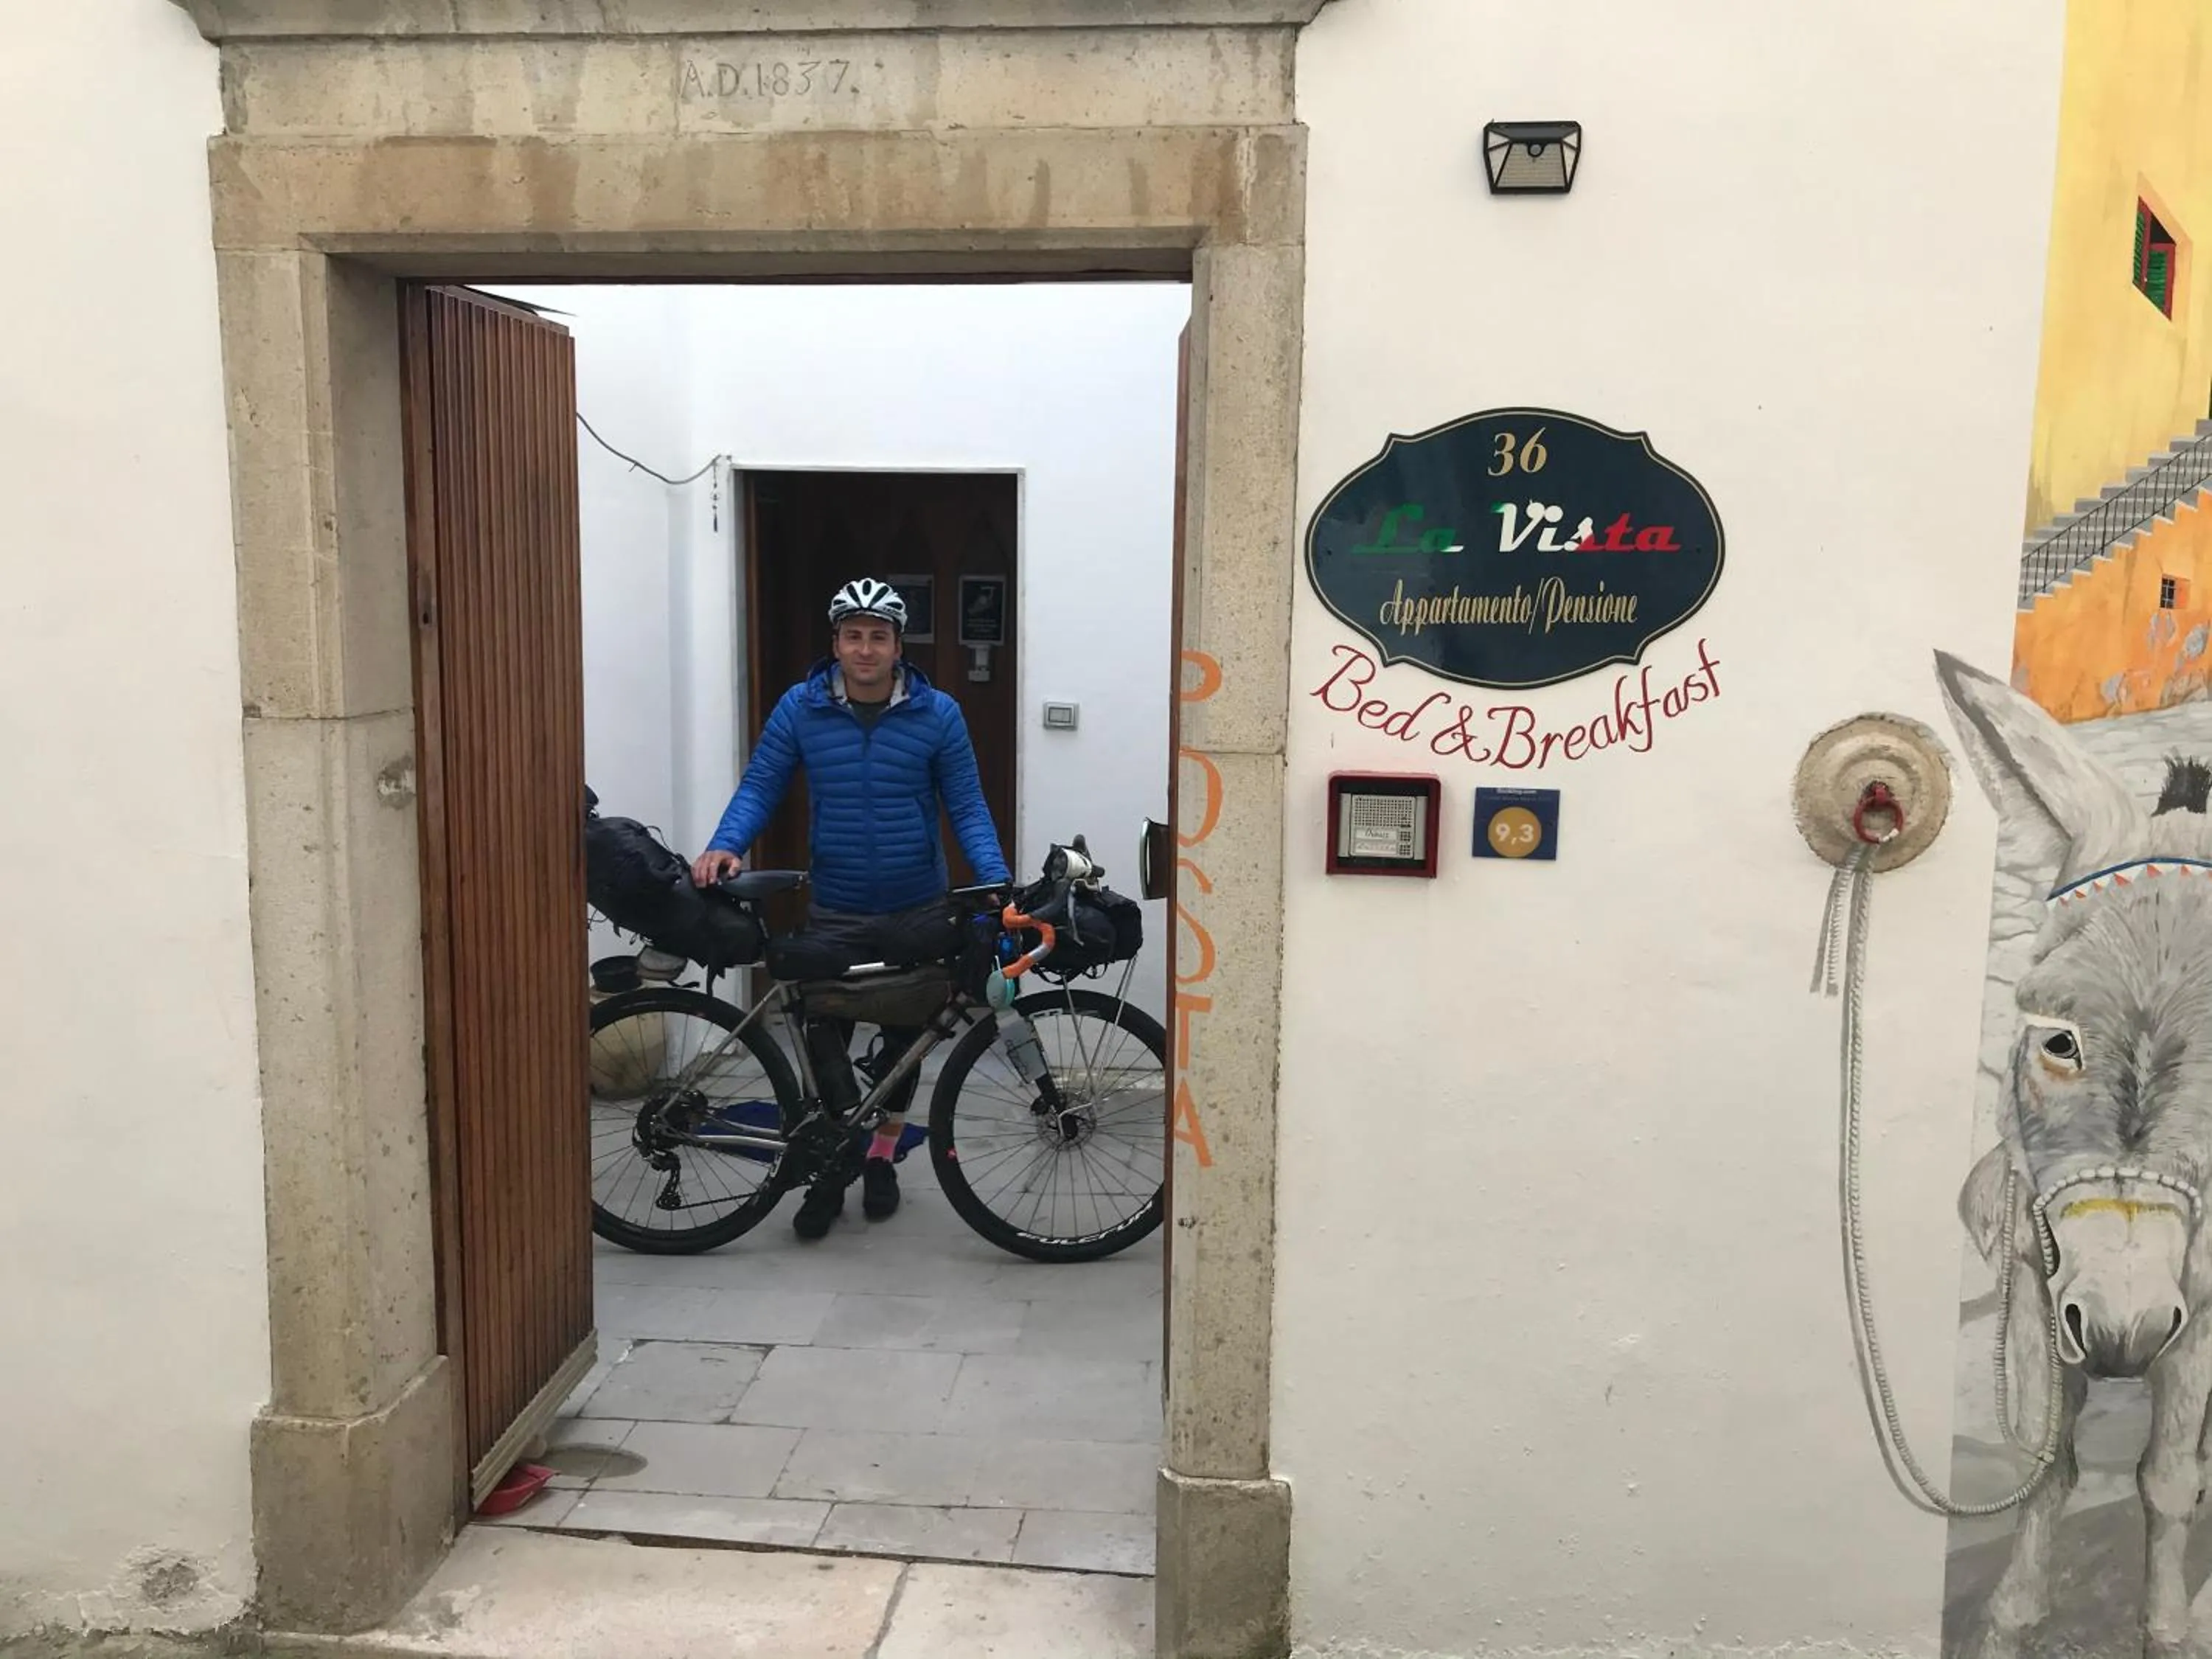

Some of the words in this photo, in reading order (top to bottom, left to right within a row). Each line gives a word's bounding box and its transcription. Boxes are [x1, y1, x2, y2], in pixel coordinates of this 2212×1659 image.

[1487, 427, 1548, 476] 36
[1351, 503, 1464, 554] La
[1491, 498, 1681, 552] Vista
[1310, 644, 1451, 741] Bed
[1430, 705, 1490, 762] &
[1487, 638, 1721, 769] Breakfast
[1495, 823, 1534, 845] 9,3
